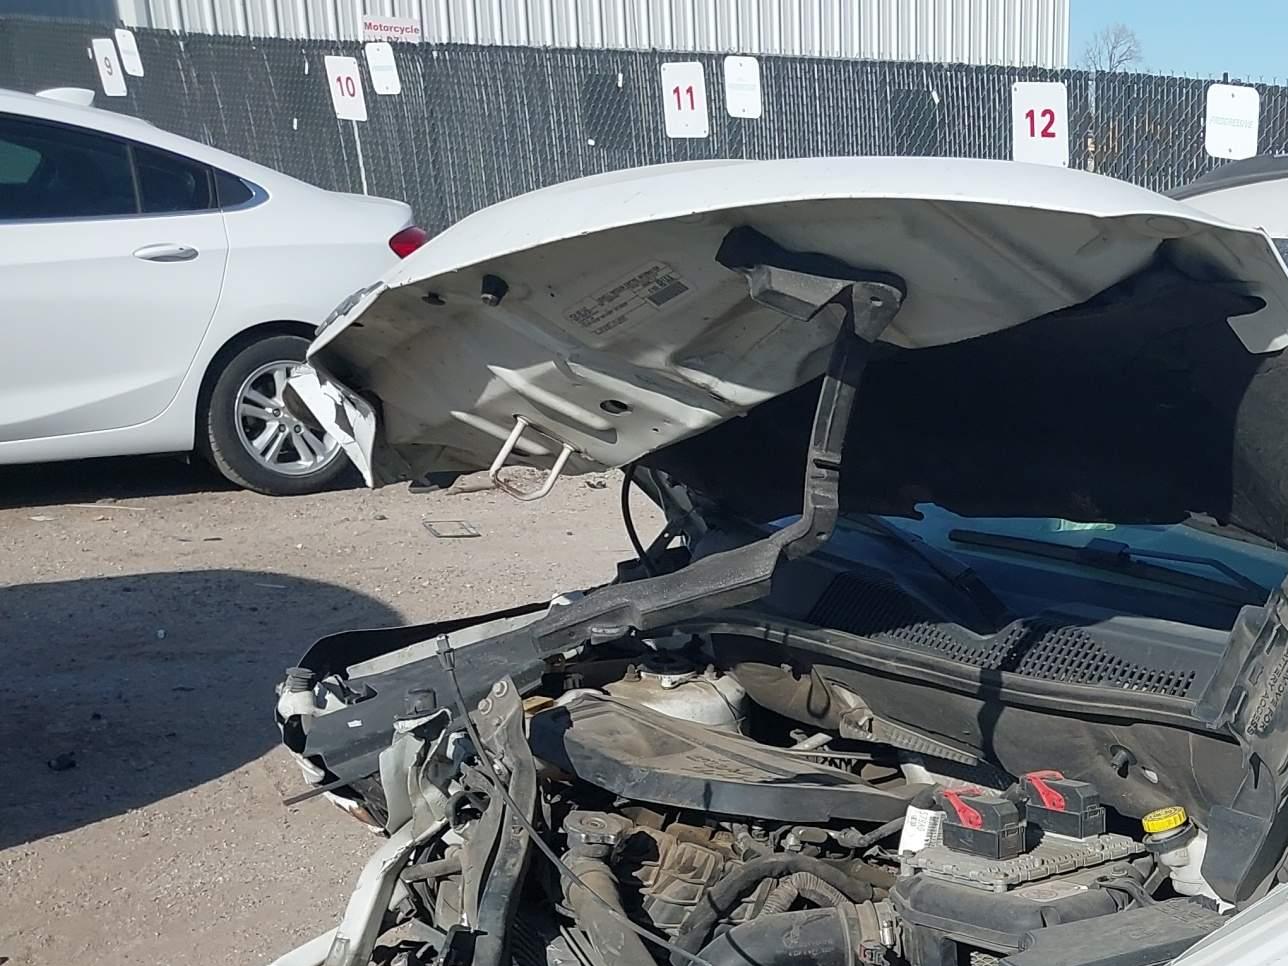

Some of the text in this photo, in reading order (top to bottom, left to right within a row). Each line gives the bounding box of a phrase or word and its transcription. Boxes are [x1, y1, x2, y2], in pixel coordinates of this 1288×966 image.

[363, 22, 420, 35] Motorcycle
[104, 56, 113, 76] 9
[336, 75, 356, 98] 10
[672, 85, 695, 111] 11
[1024, 108, 1057, 138] 12
